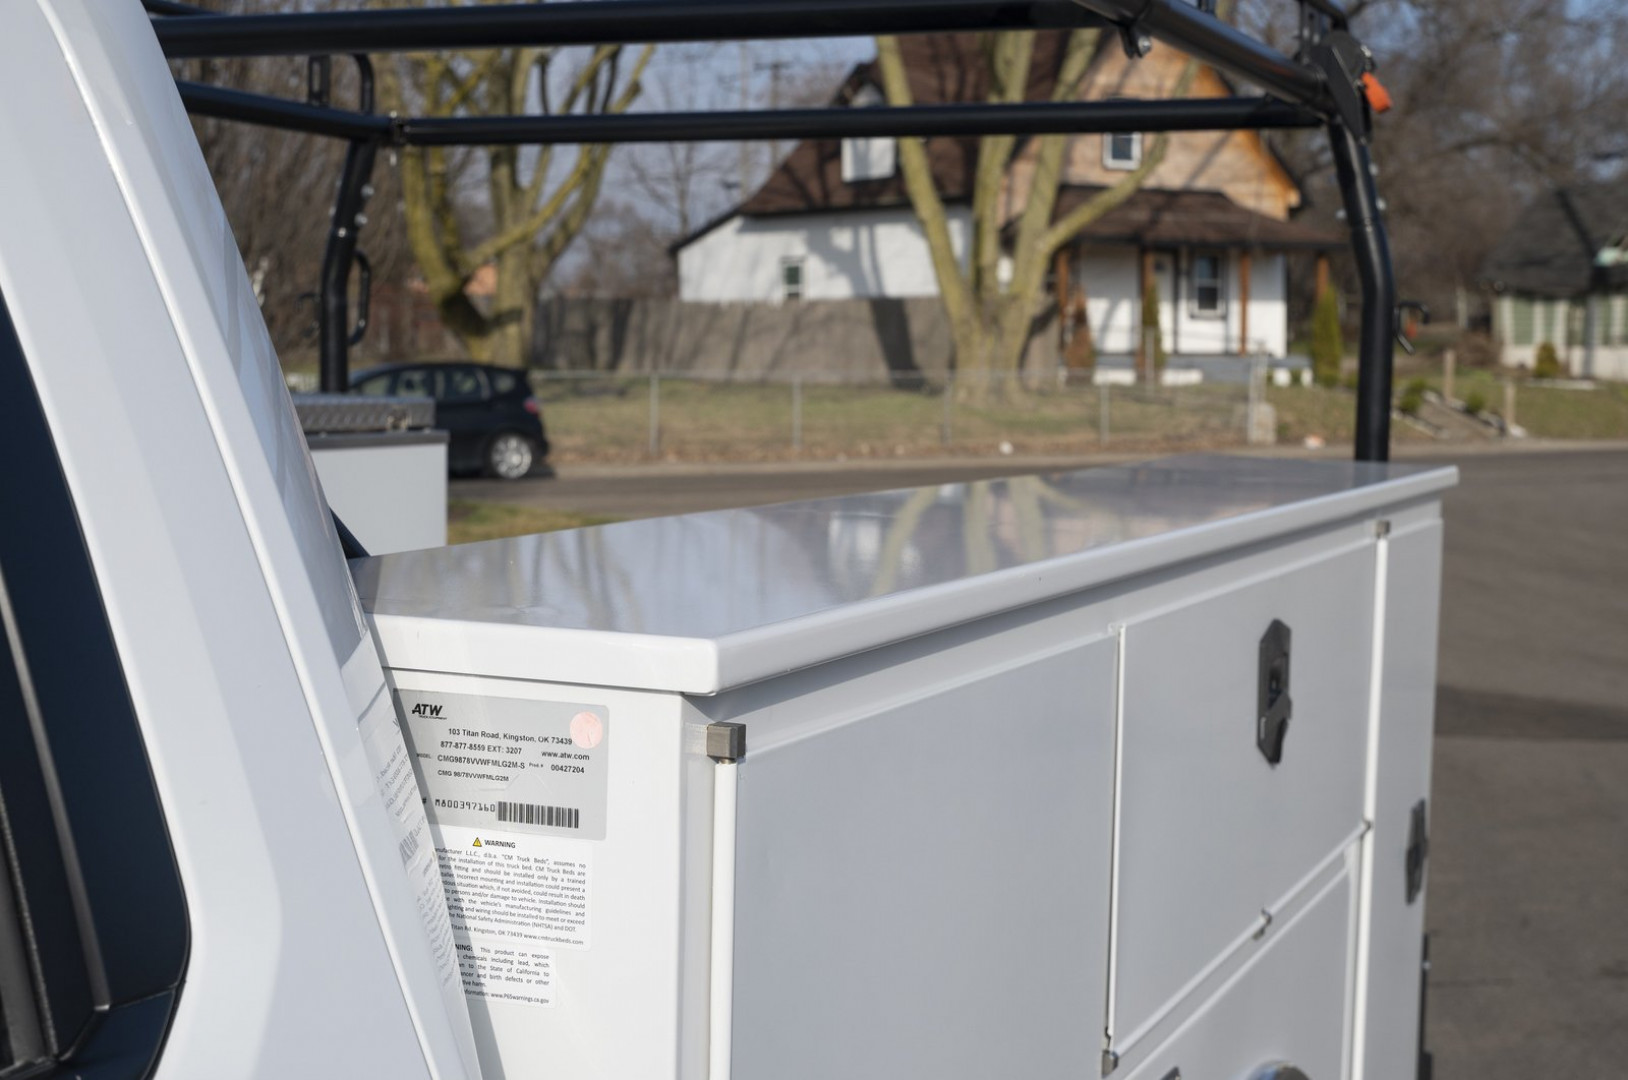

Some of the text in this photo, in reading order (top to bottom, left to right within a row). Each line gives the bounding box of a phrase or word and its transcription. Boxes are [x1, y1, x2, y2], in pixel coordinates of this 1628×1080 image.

[412, 703, 443, 716] ATW
[481, 731, 501, 740] Road,
[503, 733, 536, 742] Kingston,
[440, 741, 485, 751] 877-877-8559
[541, 751, 589, 760] www.atw.com
[551, 764, 584, 773] 00427204
[485, 839, 515, 848] WARNING
[517, 912, 538, 920] installed
[516, 968, 540, 976] California
